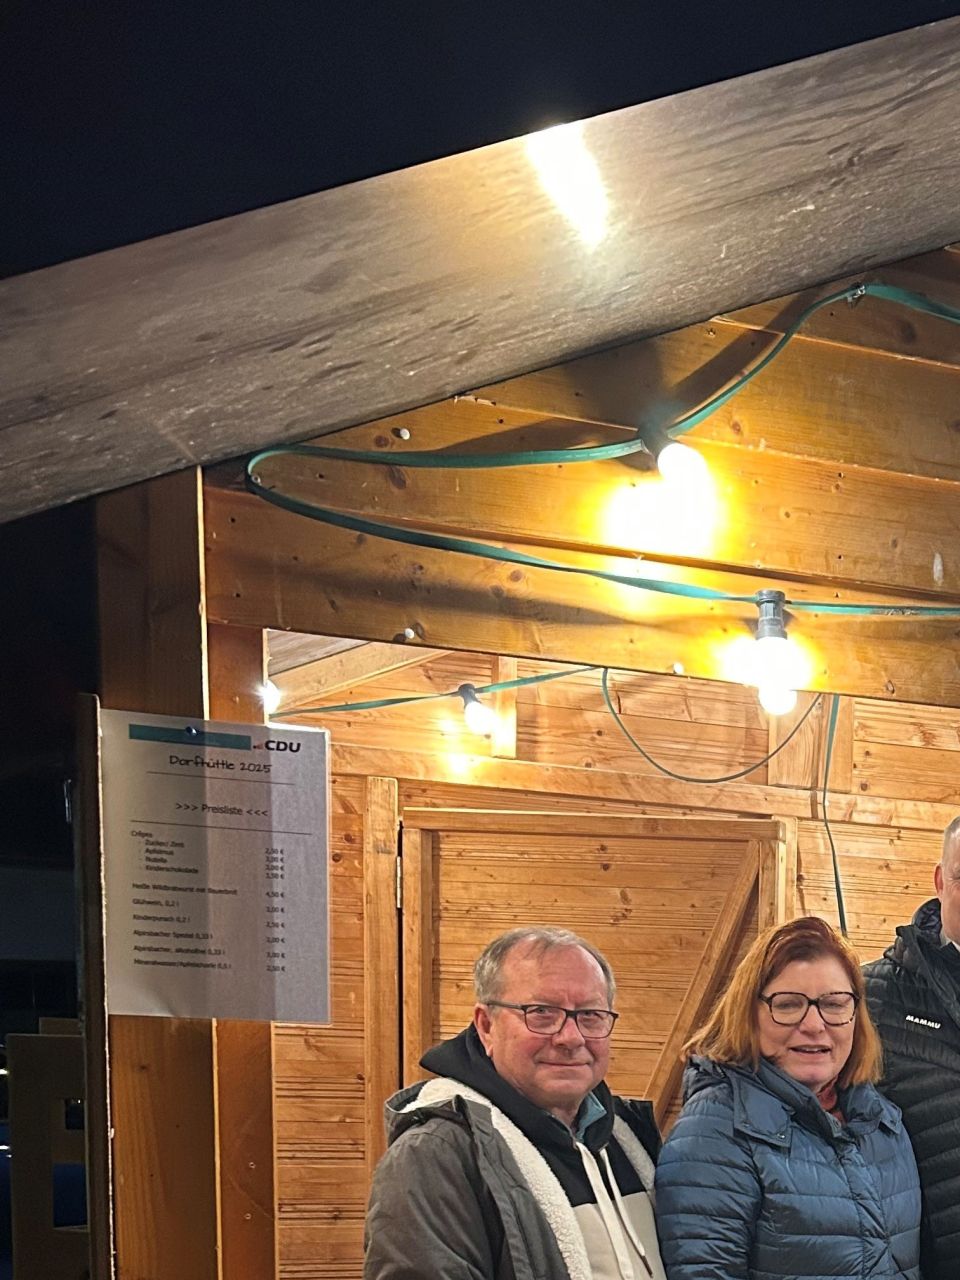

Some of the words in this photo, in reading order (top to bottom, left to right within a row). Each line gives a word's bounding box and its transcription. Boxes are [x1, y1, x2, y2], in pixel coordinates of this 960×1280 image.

[264, 739, 301, 753] CDU
[239, 761, 272, 774] 2025
[201, 803, 243, 816] Preisliste
